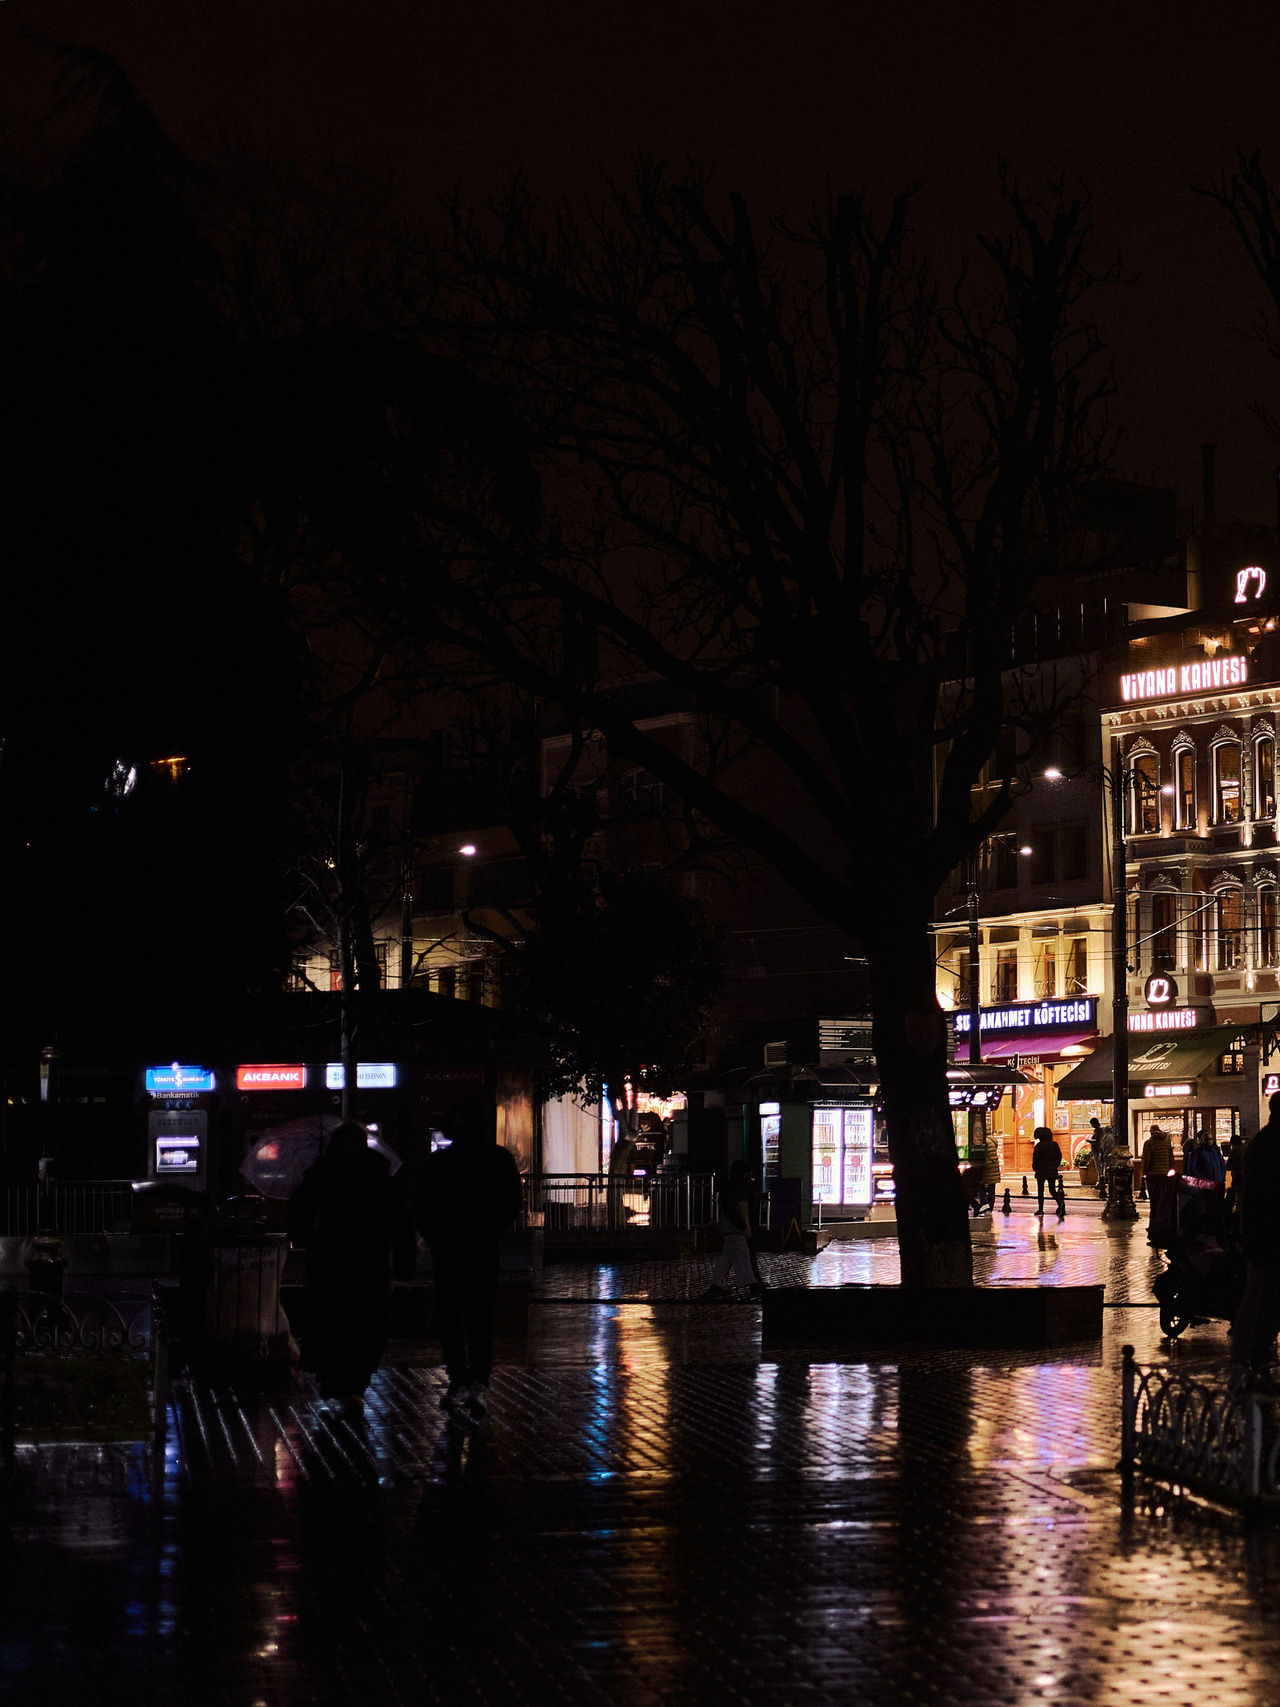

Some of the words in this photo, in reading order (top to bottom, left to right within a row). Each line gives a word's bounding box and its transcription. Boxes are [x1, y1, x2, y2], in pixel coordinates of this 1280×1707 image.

[956, 1008, 1031, 1031] SUANAHMET
[1034, 1000, 1090, 1025] KÖFTECİSİ
[242, 1072, 300, 1082] AKBANK
[365, 1072, 387, 1080] BBVA
[156, 1091, 200, 1099] Bankamatik
